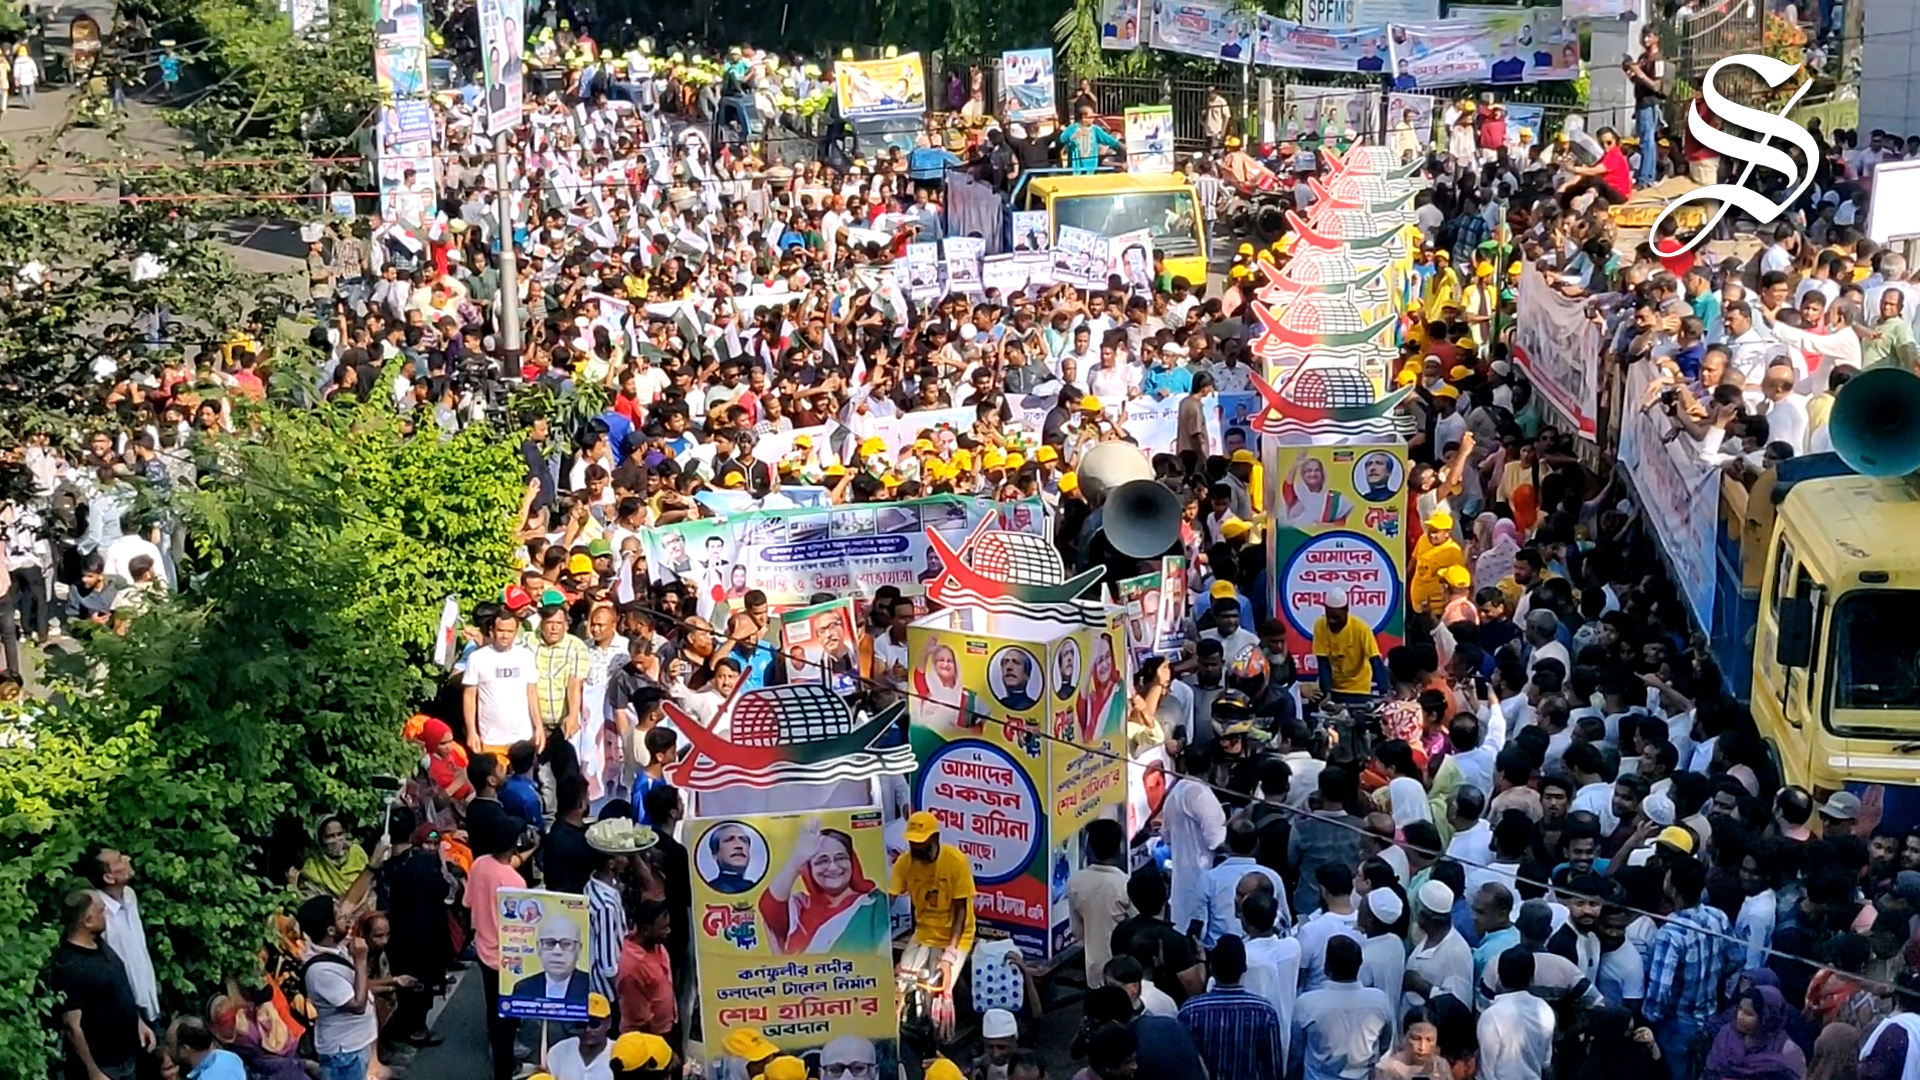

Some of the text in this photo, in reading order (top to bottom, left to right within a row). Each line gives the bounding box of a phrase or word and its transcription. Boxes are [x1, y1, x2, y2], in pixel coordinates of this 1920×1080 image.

[1308, 0, 1354, 23] SPFMS
[1305, 550, 1373, 565] আমাদের
[1299, 568, 1379, 583] একজন
[1292, 585, 1386, 611] শেখ াসিনা
[941, 758, 1014, 787] আমাদের
[935, 783, 1021, 811] একজন
[1057, 792, 1077, 816] শেখ
[971, 810, 1029, 843] হাসিনা
[738, 959, 854, 983] কর্ণফুলীর নদীর
[716, 974, 877, 1000] তলদেশে টানেল নির্মাণ
[718, 995, 878, 1027] শেখ হাসিনা'র
[762, 1020, 830, 1037] অবদান
